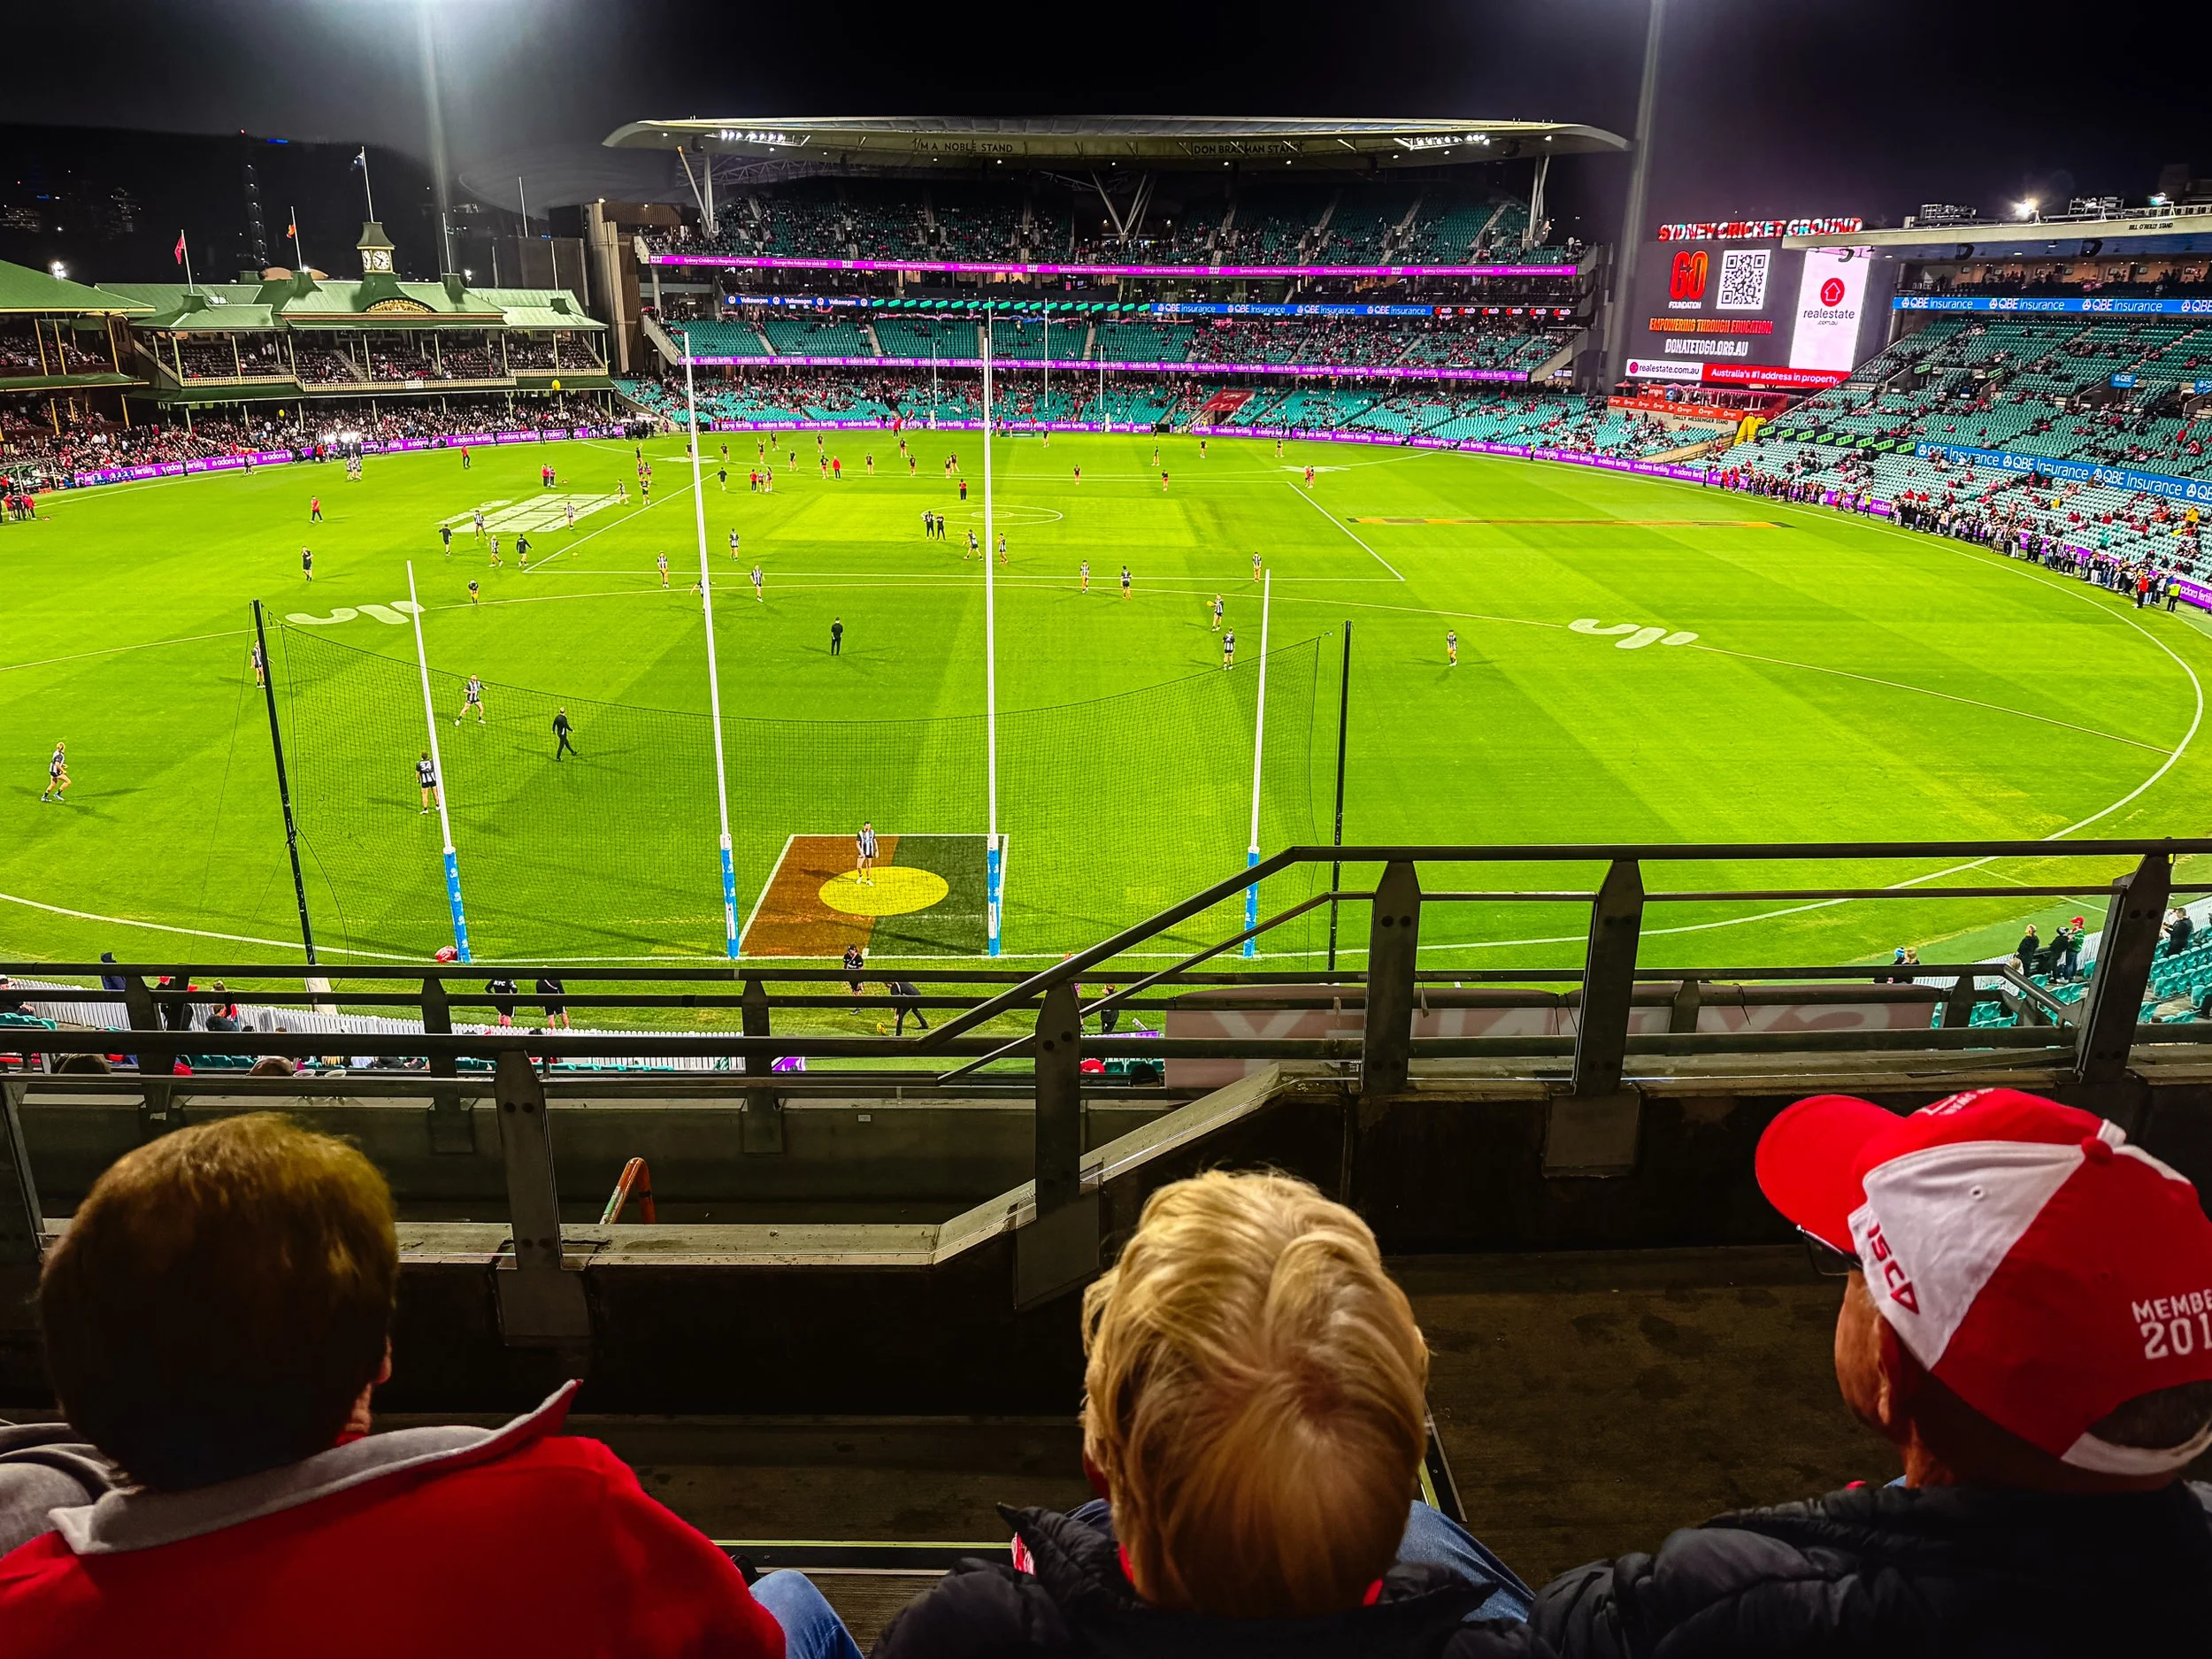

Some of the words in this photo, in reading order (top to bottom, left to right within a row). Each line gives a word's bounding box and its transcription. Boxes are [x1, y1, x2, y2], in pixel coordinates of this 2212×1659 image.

[944, 142, 976, 151] NOBLE
[981, 143, 1013, 152] STAND
[1194, 145, 1216, 154] DON
[1658, 223, 1717, 242] SYDNEY
[1717, 220, 1786, 239] CRICKET
[1786, 218, 1863, 237] GROUND
[1670, 250, 1709, 301] GO
[1165, 303, 1180, 312] QBE
[1181, 303, 1216, 313] Insurance
[1251, 304, 1285, 313] Insurance
[1304, 305, 1319, 314] QBE
[1320, 305, 1356, 314] Insurance
[1374, 305, 1390, 314] QBE
[1391, 305, 1426, 315] Insurance
[1909, 297, 1930, 309] QBE
[1931, 297, 1973, 310] Insurance
[1998, 298, 2019, 310] QBE
[2019, 298, 2065, 311] Insurance
[2092, 299, 2115, 311] QBE
[2114, 299, 2162, 312] Insurance
[1803, 308, 1855, 319] realestate
[1649, 318, 1696, 332] EMPOWERING
[1696, 319, 1731, 333] THROUGH
[1731, 319, 1773, 334] EDUCATION
[1664, 338, 1749, 357] DONATETOGO.ORG.AU
[1640, 364, 1699, 375] realestate.com.au
[1711, 368, 1750, 378] Australia's
[1761, 372, 1792, 380] address
[1801, 374, 1839, 385] property.
[134, 465, 156, 476] fertility
[2012, 456, 2035, 470] QBE
[2036, 458, 2089, 479] Insurance
[2103, 469, 2125, 485] QBE
[2127, 472, 2182, 495] Insurance
